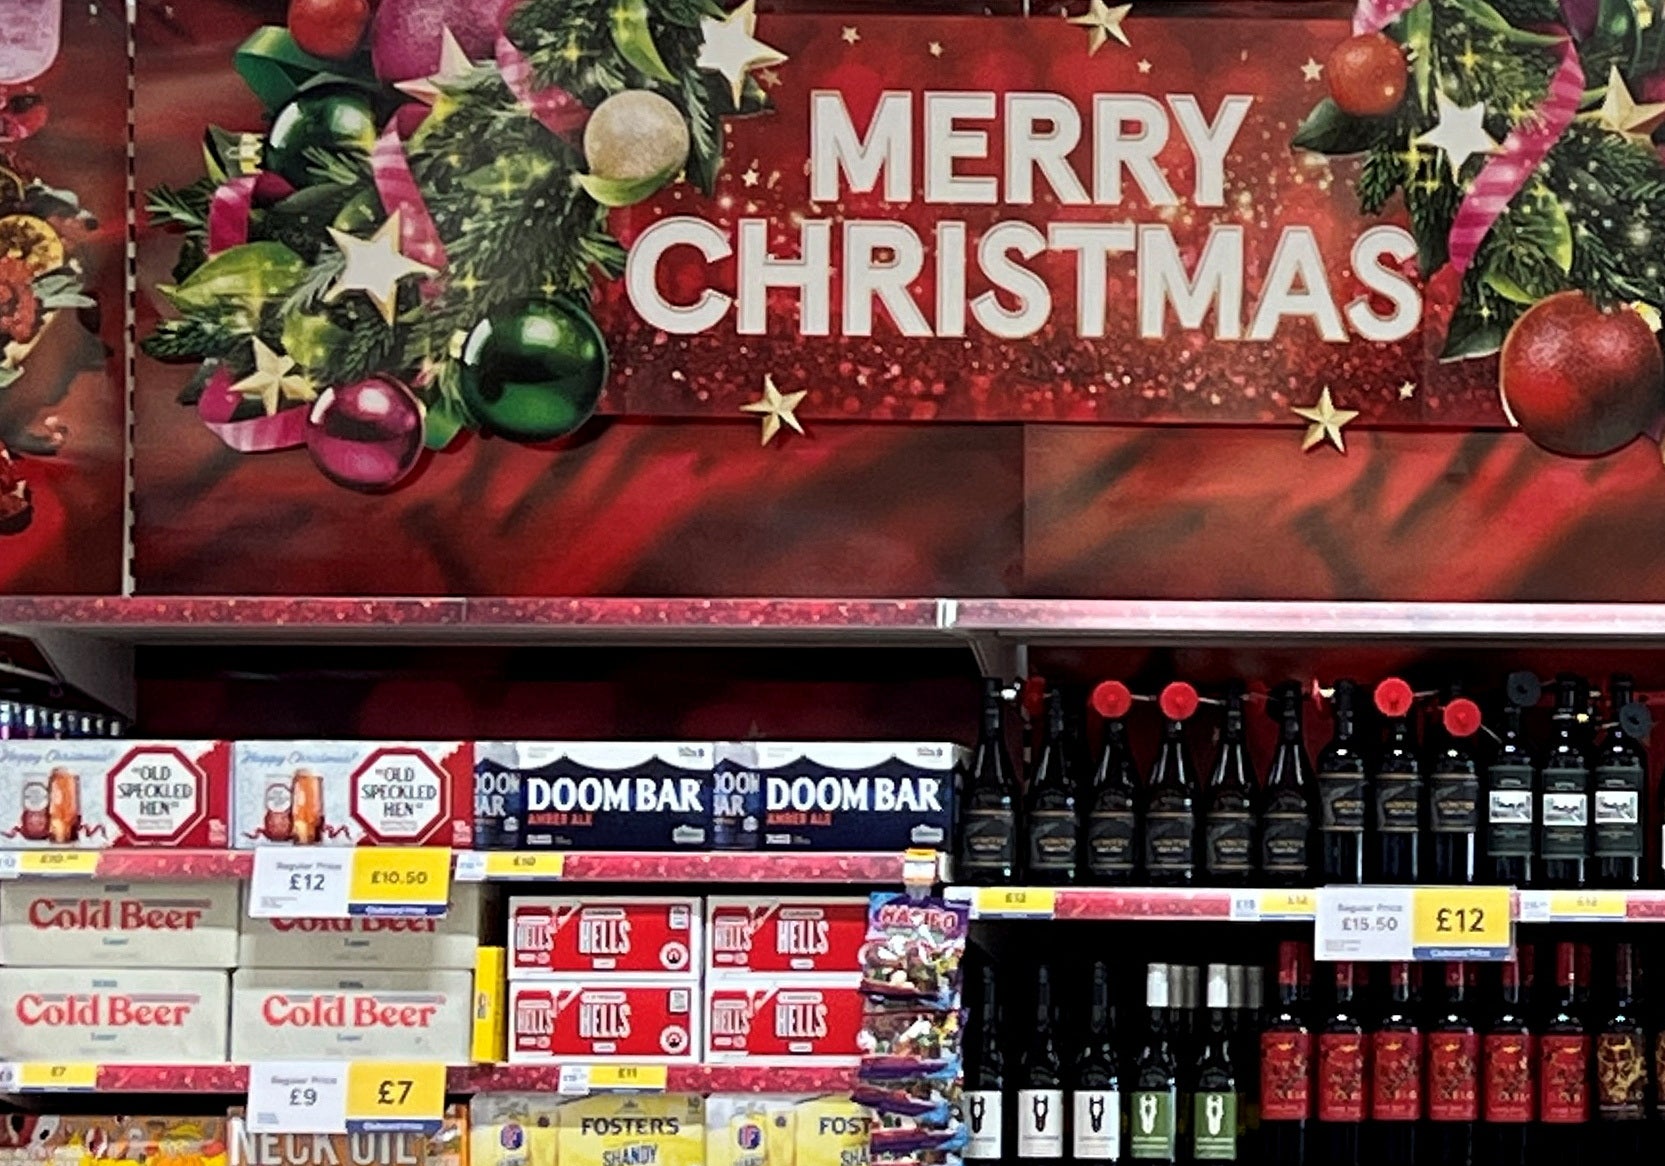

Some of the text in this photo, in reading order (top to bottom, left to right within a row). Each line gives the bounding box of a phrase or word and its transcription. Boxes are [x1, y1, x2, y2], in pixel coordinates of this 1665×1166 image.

[809, 90, 1254, 207] MERRY
[626, 216, 1424, 342] CHRISTMAS
[117, 783, 193, 800] SPECKLED
[361, 784, 437, 800] SPECKLED
[527, 777, 704, 812] DOOM BAR
[766, 776, 943, 811] DOOM BAR
[527, 812, 593, 826] AMBER ALE
[766, 811, 832, 826] AMBER ALE
[287, 873, 326, 892] £12
[370, 870, 428, 886] £10.50
[28, 898, 203, 930] Cold Beer
[1341, 916, 1398, 932] £15.50
[1436, 909, 1485, 933] £12
[578, 918, 631, 954] HELLS
[776, 919, 829, 955] HELLS
[16, 993, 192, 1026] Cold Beer
[262, 994, 437, 1027] Cold Beer
[579, 1002, 631, 1038] HELLS
[775, 1003, 828, 1038] HELLS
[289, 1089, 317, 1106] £9
[378, 1080, 414, 1105] £7
[228, 1117, 417, 1166] NECK OIL
[581, 1117, 680, 1136] FOSTER'S
